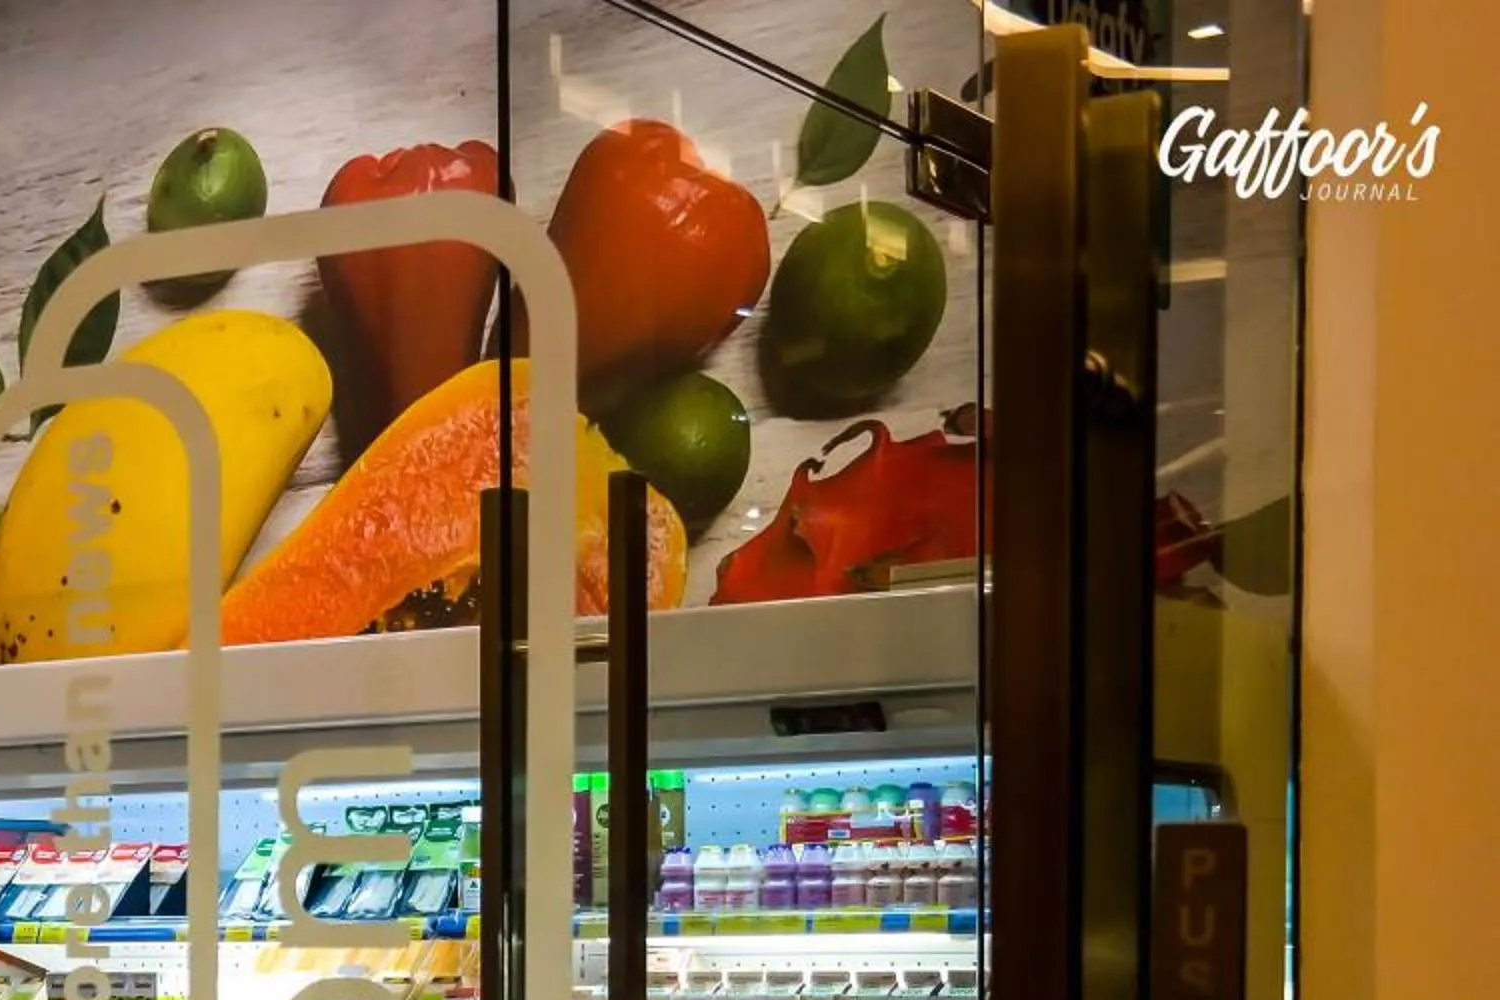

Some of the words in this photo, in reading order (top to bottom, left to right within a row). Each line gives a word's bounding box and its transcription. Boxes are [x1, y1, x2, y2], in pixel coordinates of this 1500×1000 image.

[66, 430, 114, 645] news
[51, 676, 113, 851] than
[1180, 848, 1217, 994] PUS
